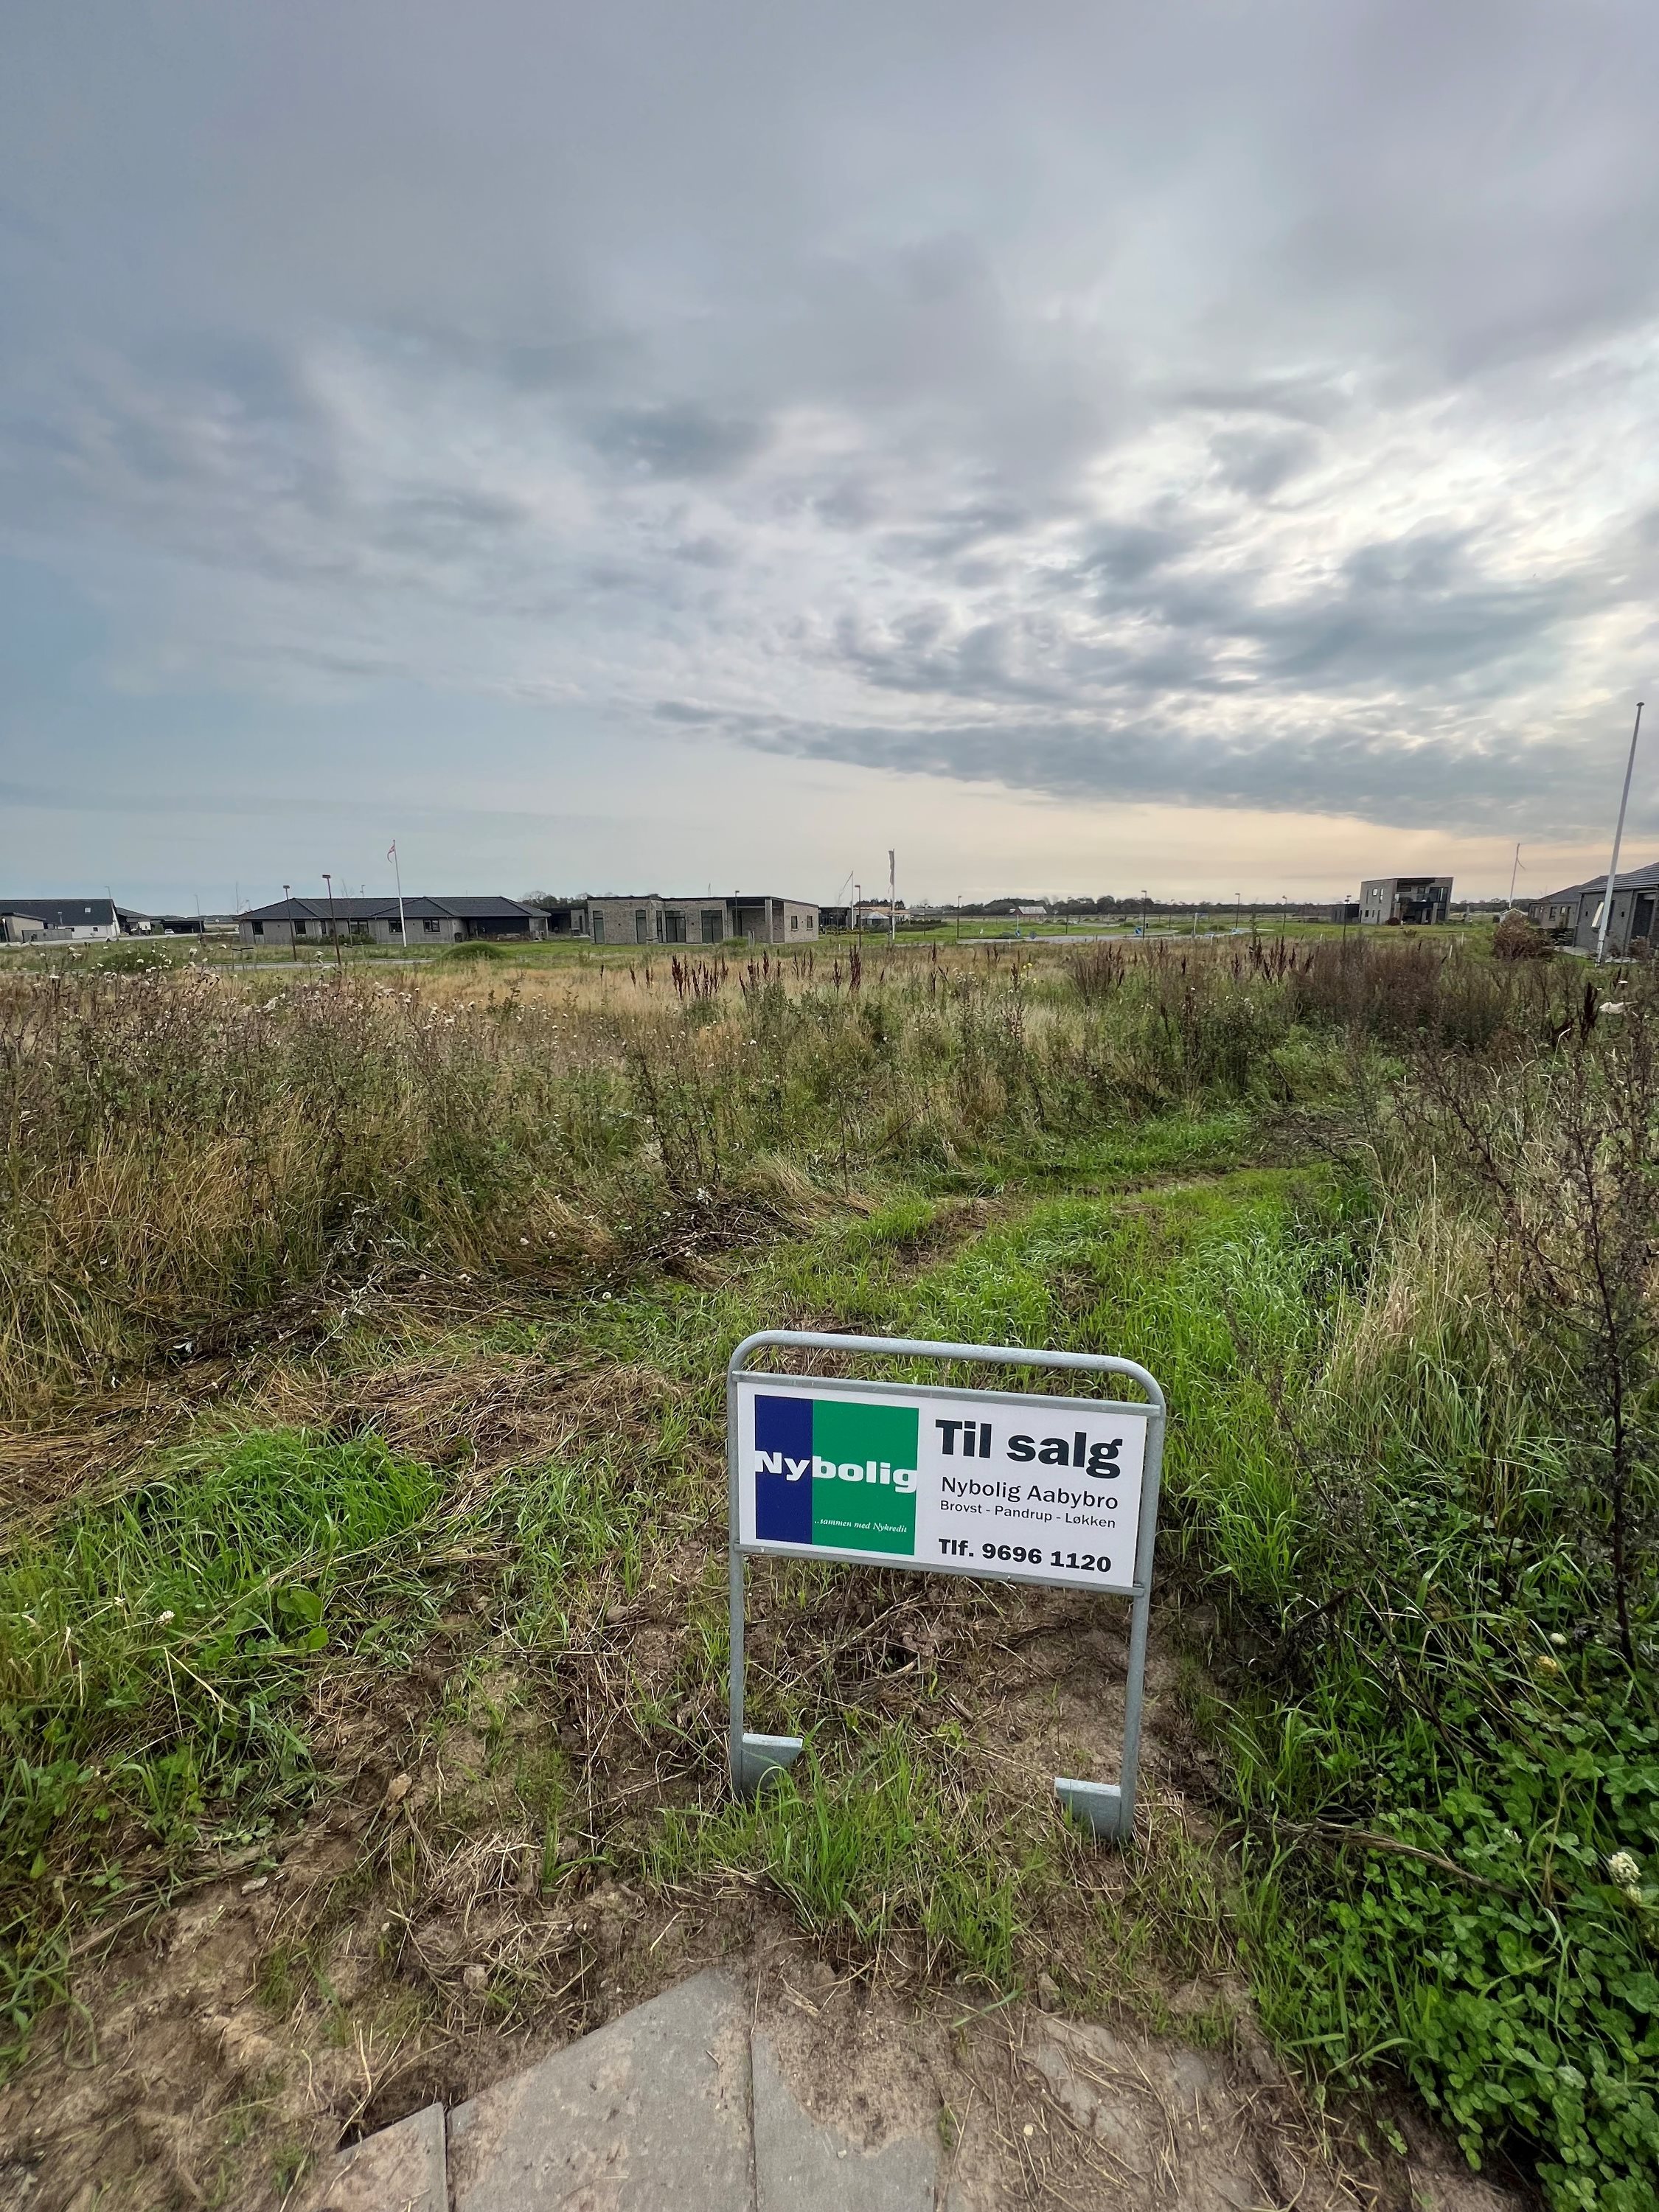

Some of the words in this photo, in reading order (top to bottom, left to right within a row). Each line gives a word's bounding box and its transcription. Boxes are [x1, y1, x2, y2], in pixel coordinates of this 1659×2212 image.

[935, 1419, 992, 1458] Til
[1006, 1431, 1123, 1479] salg
[755, 1450, 918, 1493] Nybolig
[942, 1476, 1021, 1503] Nybolig
[1027, 1485, 1119, 1509] Aabybro
[872, 1523, 907, 1533] Nykredit
[940, 1500, 982, 1514] Brovst
[995, 1505, 1052, 1523] Pandrup
[1065, 1512, 1116, 1528] Løkken
[938, 1538, 974, 1557] Tlf.
[982, 1543, 1042, 1565] 9696
[1050, 1551, 1112, 1573] 1120
